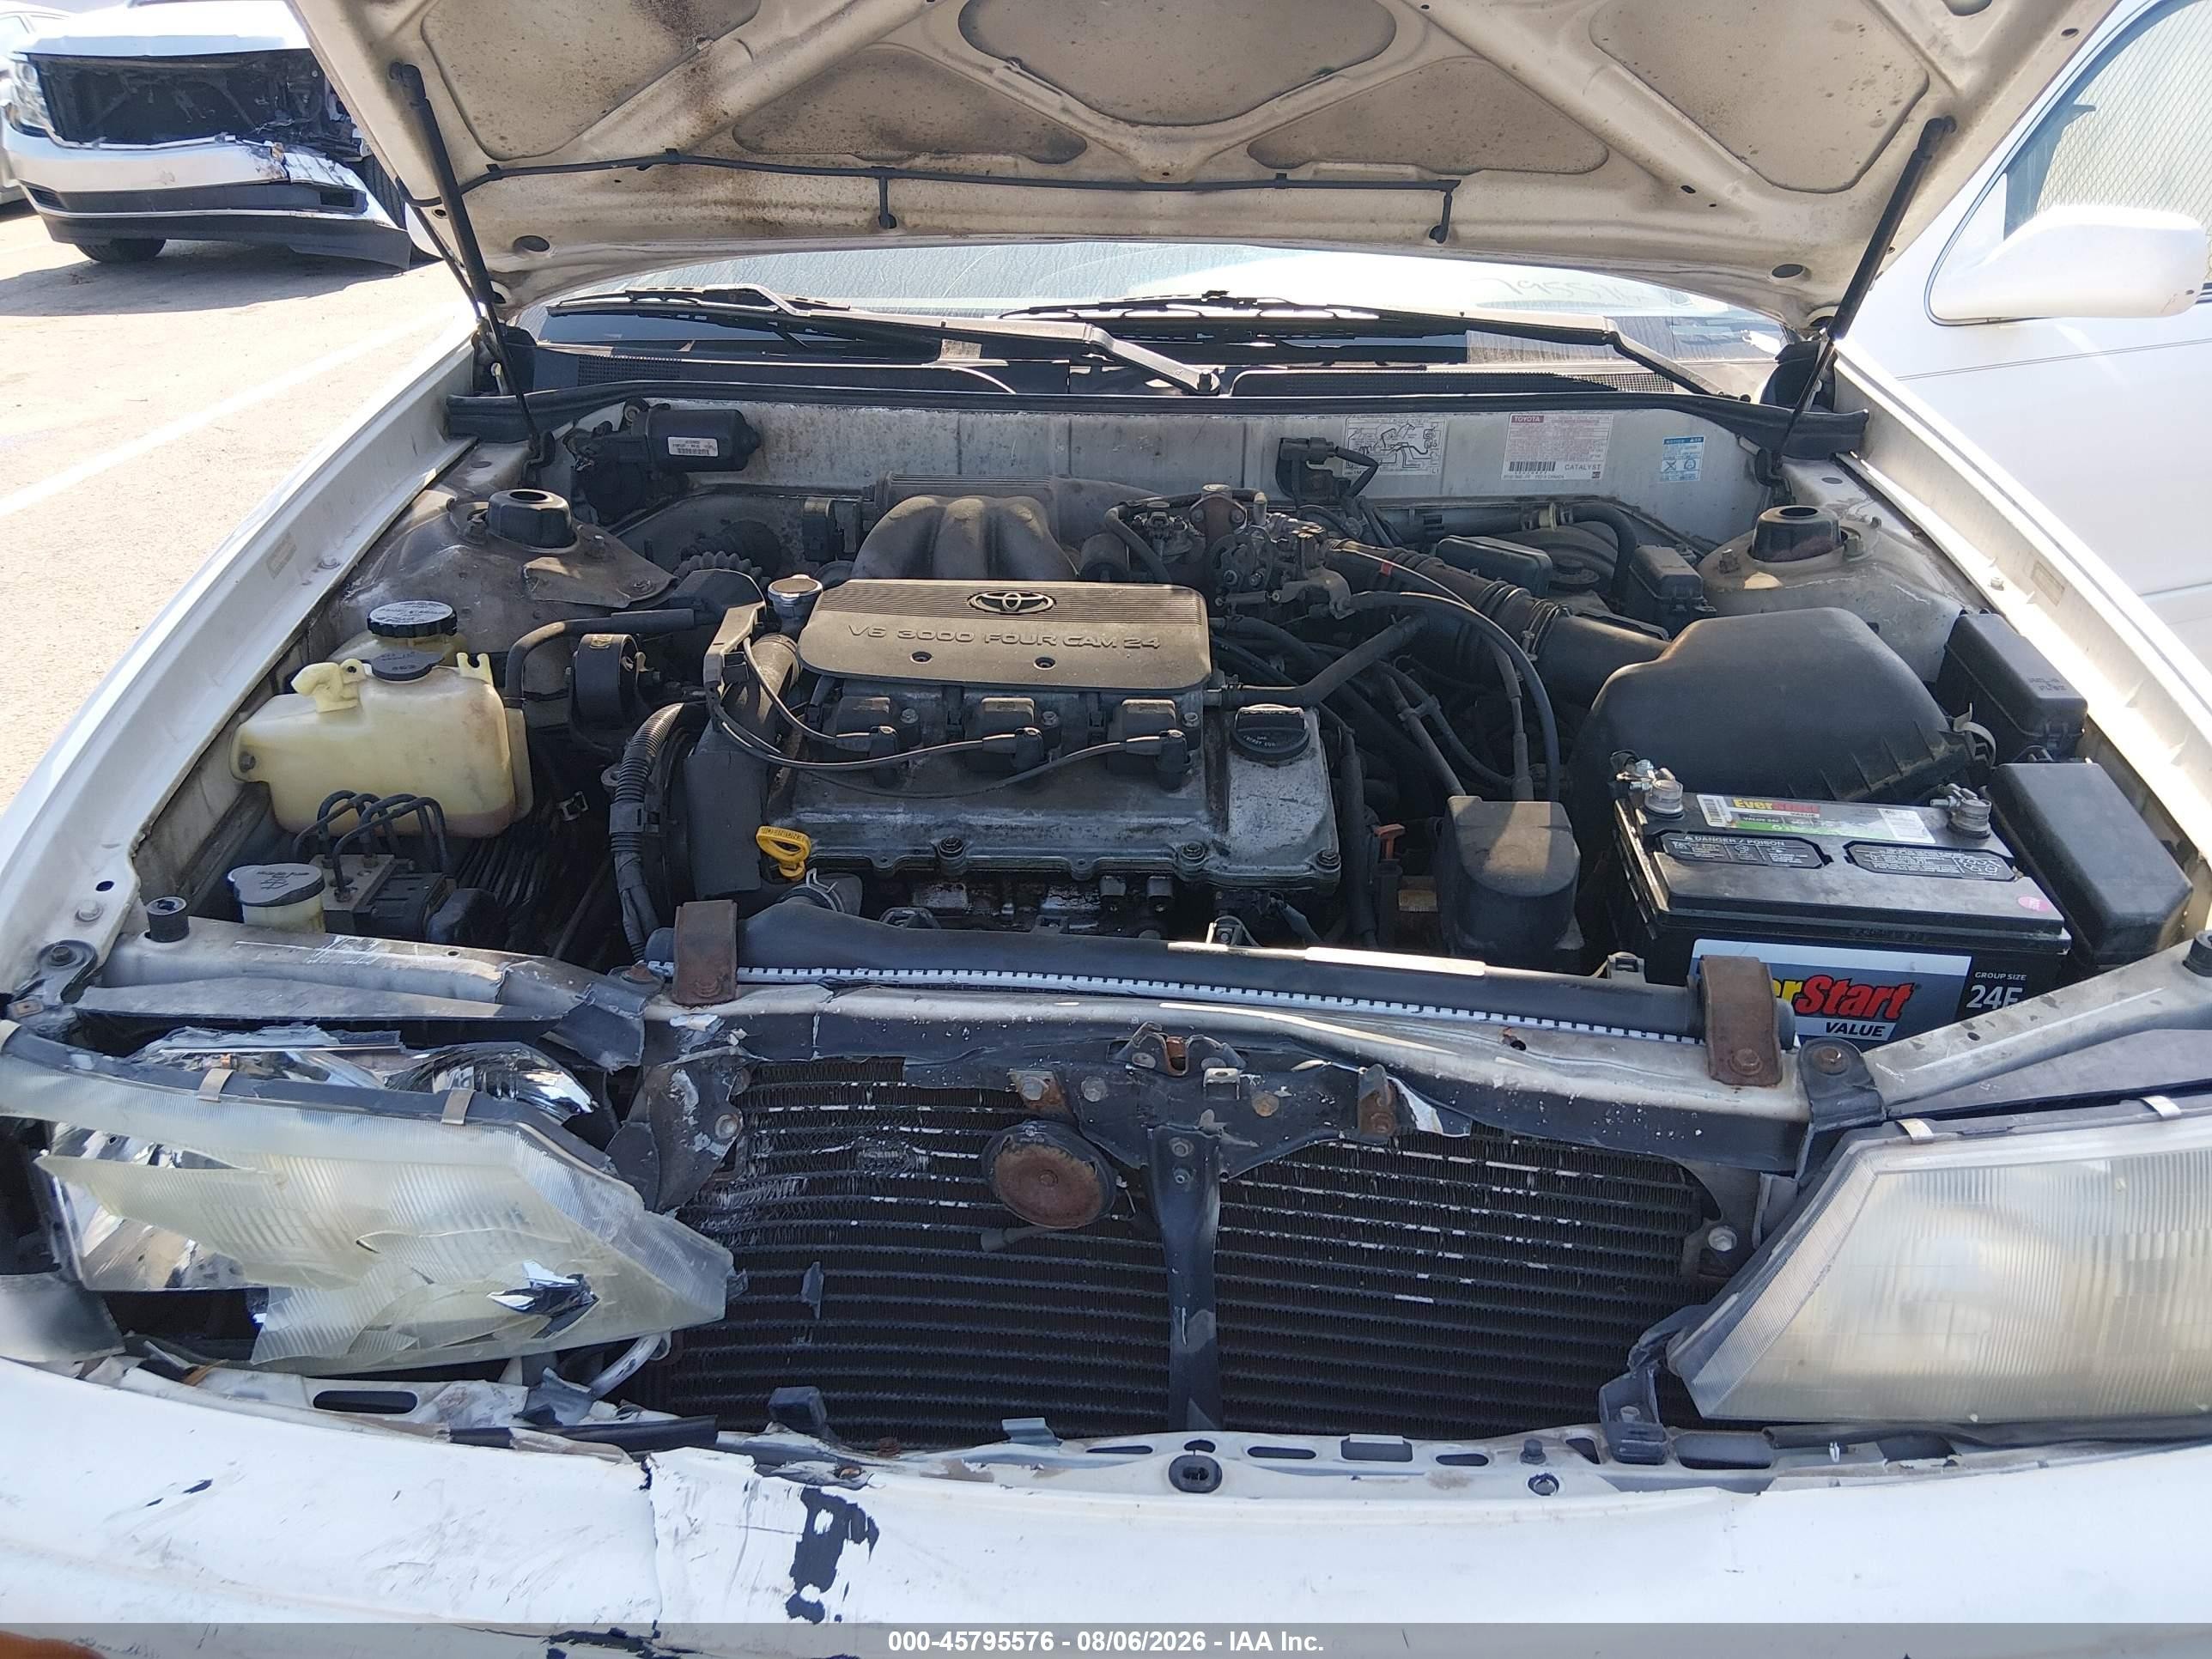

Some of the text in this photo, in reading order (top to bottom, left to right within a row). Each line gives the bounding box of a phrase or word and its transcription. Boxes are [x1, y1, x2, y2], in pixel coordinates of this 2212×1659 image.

[848, 623, 1161, 650] V6 3000 FOUR CAM 24
[1694, 836, 1737, 844] DANGER
[1974, 971, 2027, 981] GROUP SIZE
[1825, 1022, 1887, 1037] VALUE
